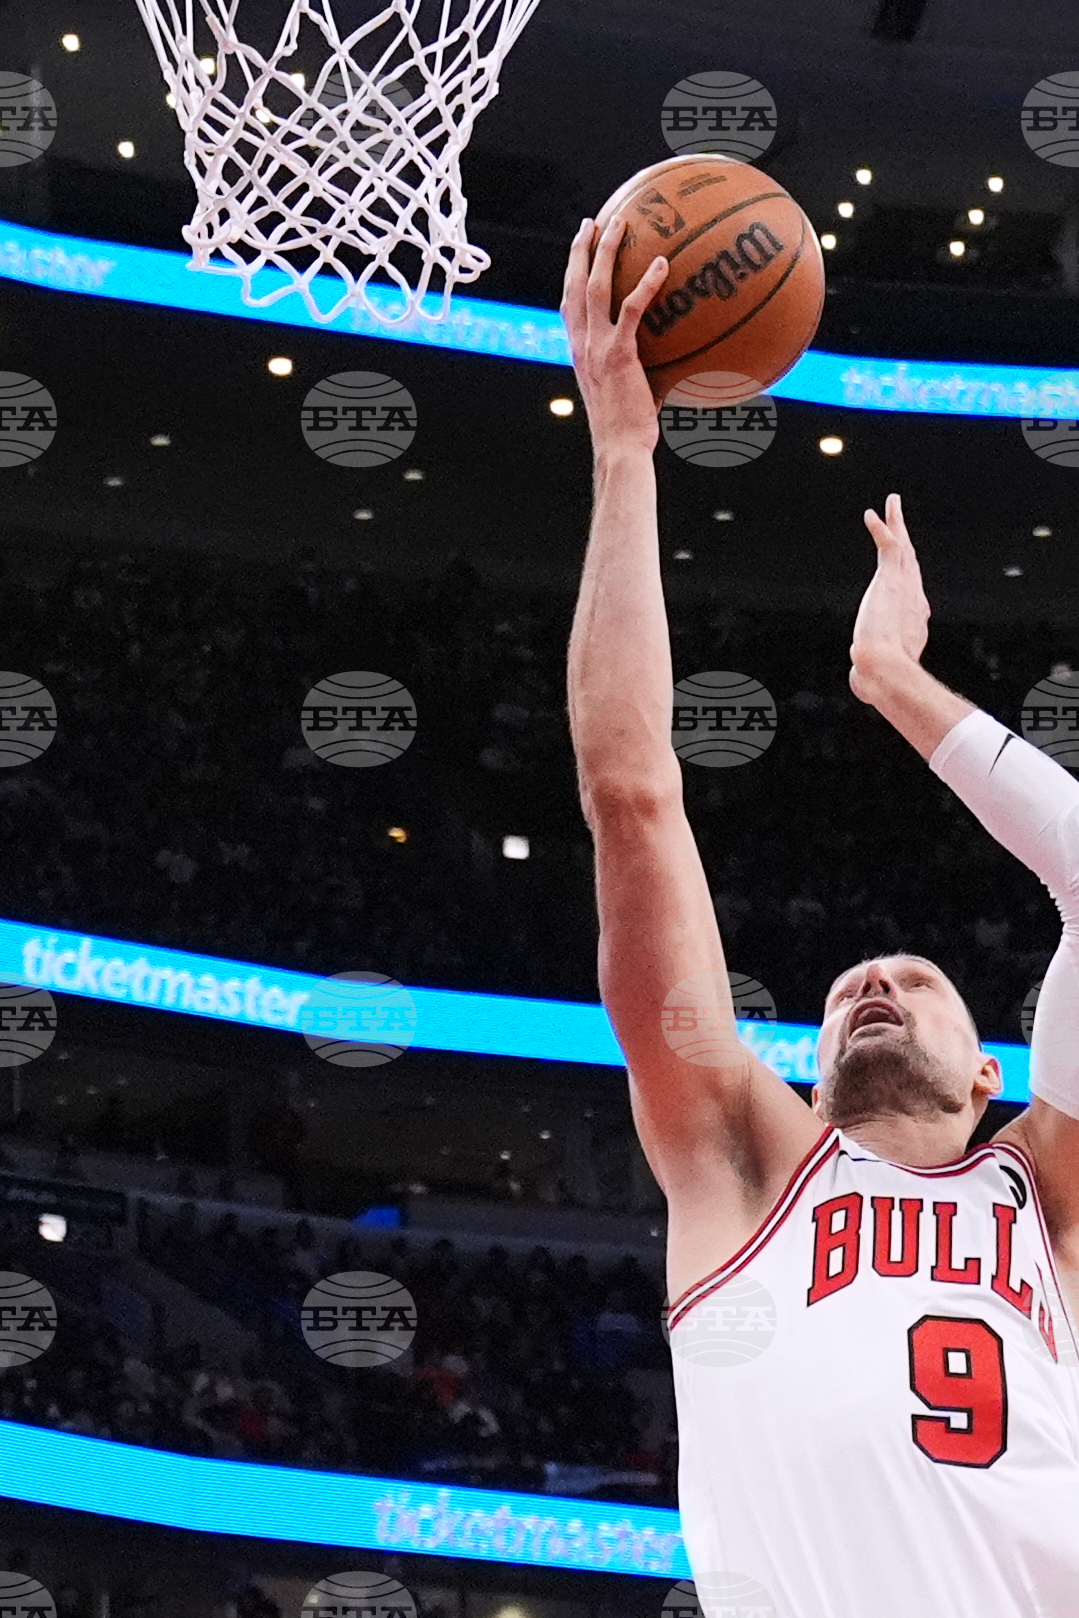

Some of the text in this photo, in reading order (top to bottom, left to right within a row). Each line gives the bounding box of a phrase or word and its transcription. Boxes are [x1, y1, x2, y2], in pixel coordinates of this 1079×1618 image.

[641, 221, 784, 337] Wilson
[22, 937, 309, 1026] ticketmaster
[908, 1314, 1008, 1469] 9
[373, 1487, 683, 1573] ticketmaster
